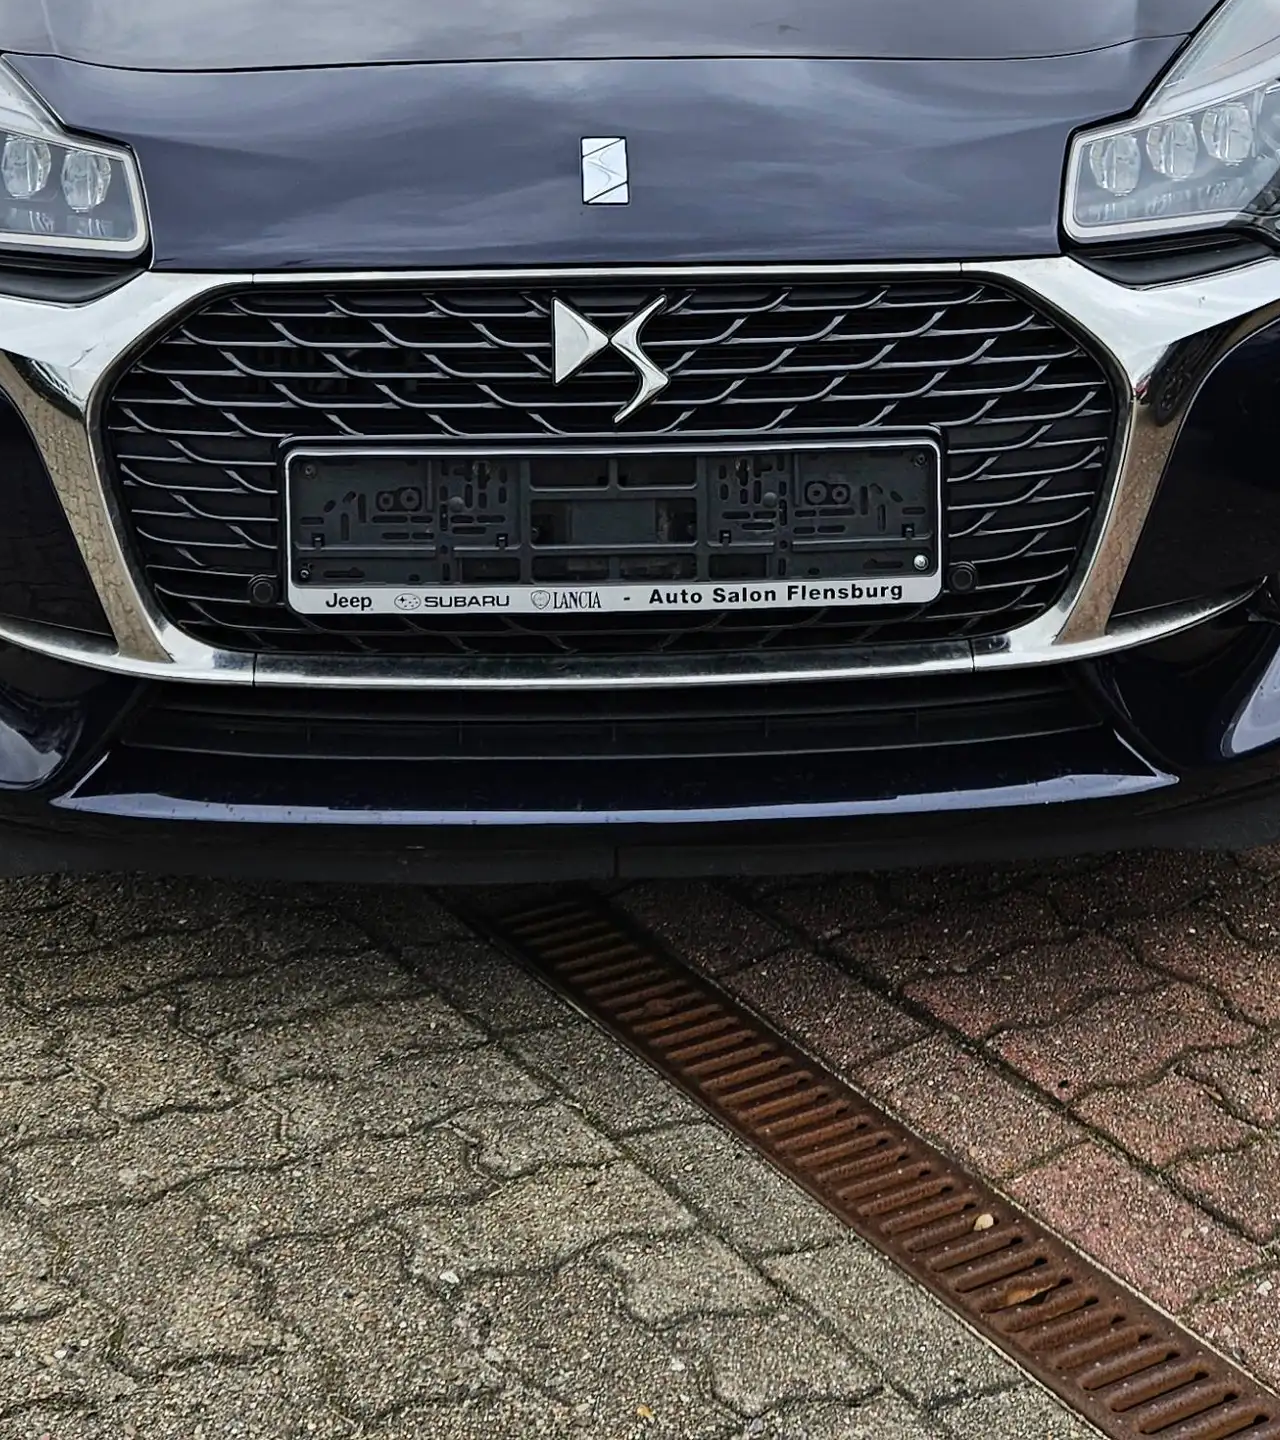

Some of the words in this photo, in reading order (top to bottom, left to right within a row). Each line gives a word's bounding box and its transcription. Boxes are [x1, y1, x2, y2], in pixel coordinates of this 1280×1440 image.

[325, 592, 373, 611] Jeep
[423, 594, 511, 608] SUBARU
[552, 590, 602, 609] LANCIA
[648, 588, 703, 605] Auto
[711, 586, 777, 603] Salon
[786, 582, 904, 601] Flensburg
